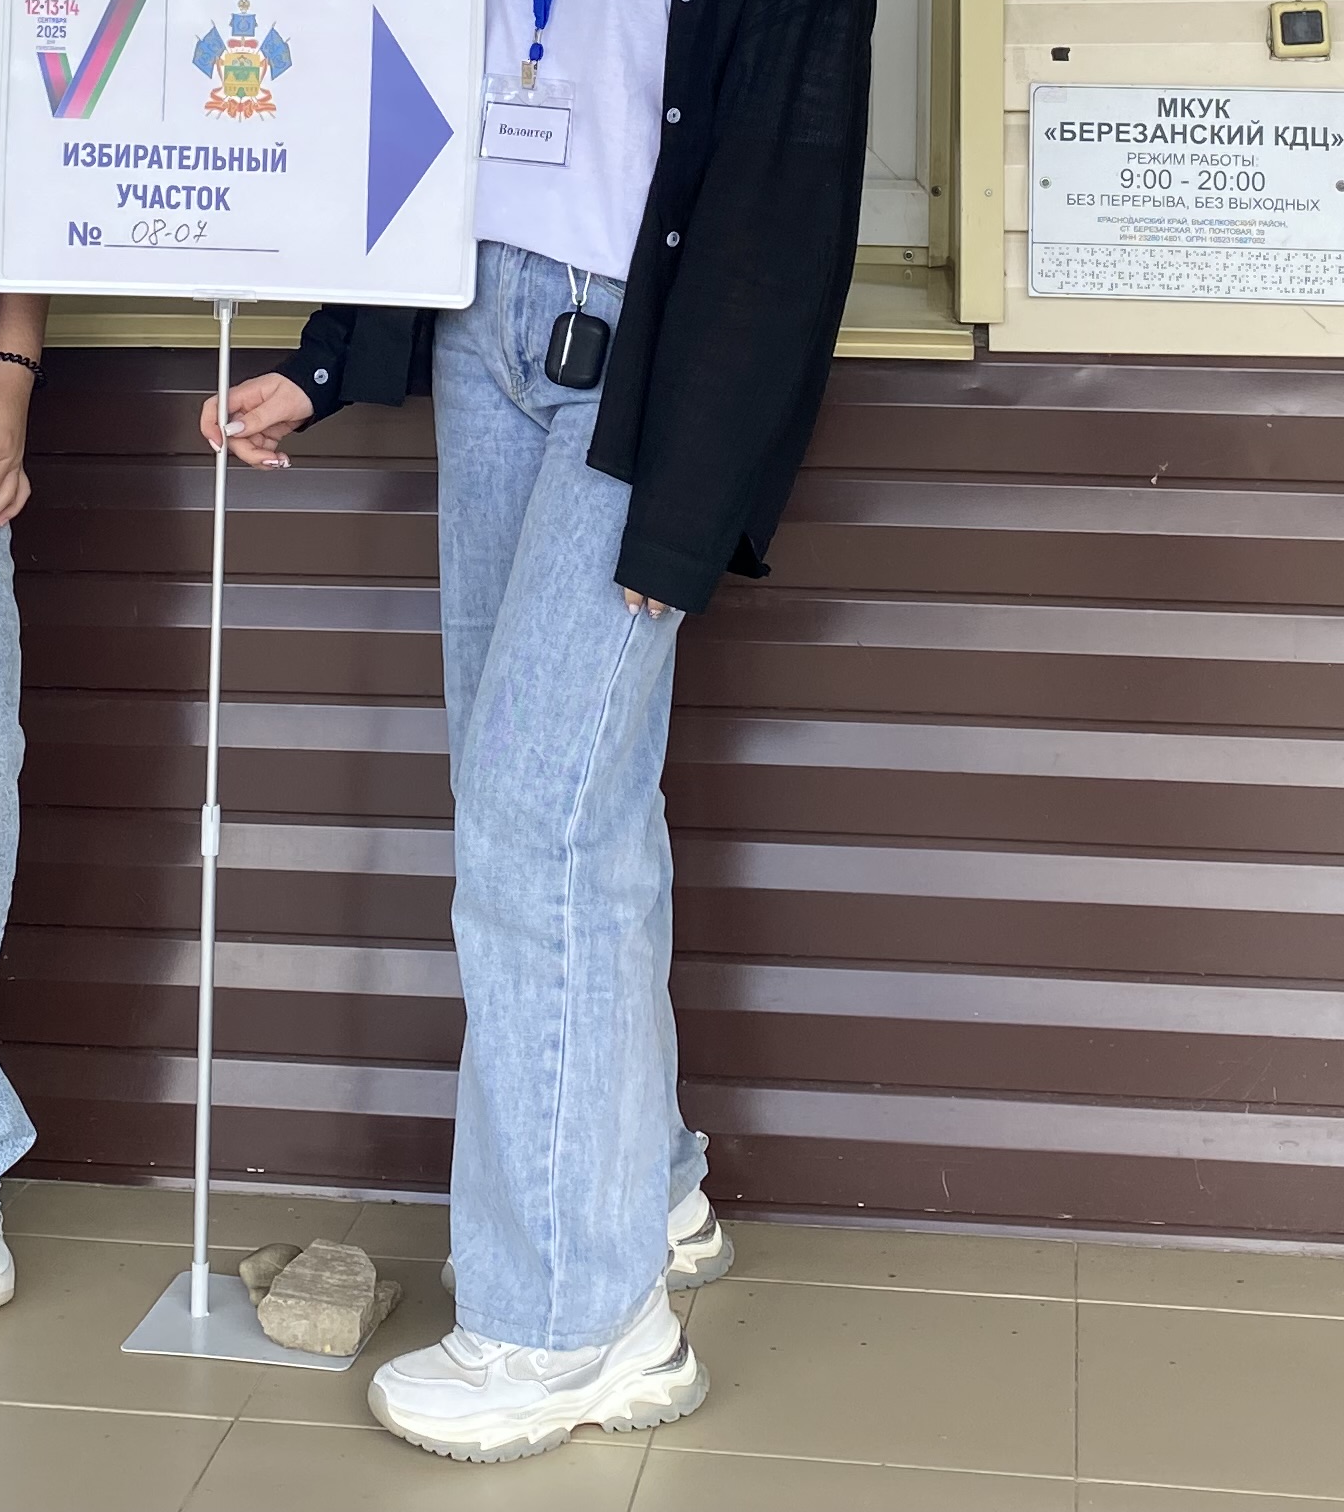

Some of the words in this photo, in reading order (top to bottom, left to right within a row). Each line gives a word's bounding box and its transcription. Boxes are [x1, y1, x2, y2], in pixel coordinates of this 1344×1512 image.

[37, 25, 67, 38] 2025
[1157, 97, 1231, 119] МКУК
[499, 124, 553, 141] Волонтер
[1044, 120, 1264, 146] «БЕРЕЗАНСКИЙ
[1274, 126, 1344, 151] КДЦ»
[63, 142, 287, 174] ИЗБИРАТЕЛЬНЫЙ
[1127, 153, 1186, 166] РЕЖИМ
[1190, 154, 1259, 167] РАБОТЫ:
[1120, 168, 1172, 190] 9:00
[1197, 170, 1266, 192] 20:00
[117, 183, 231, 212] УЧАСТОК
[1066, 194, 1095, 206] БЕЗ
[1100, 194, 1190, 210] ПЕРЕРЫВА,
[1195, 196, 1224, 209] БЕЗ
[1229, 197, 1321, 212] ВЫХОДНЫХ
[68, 221, 102, 246] №
[132, 220, 208, 247] 08-07
